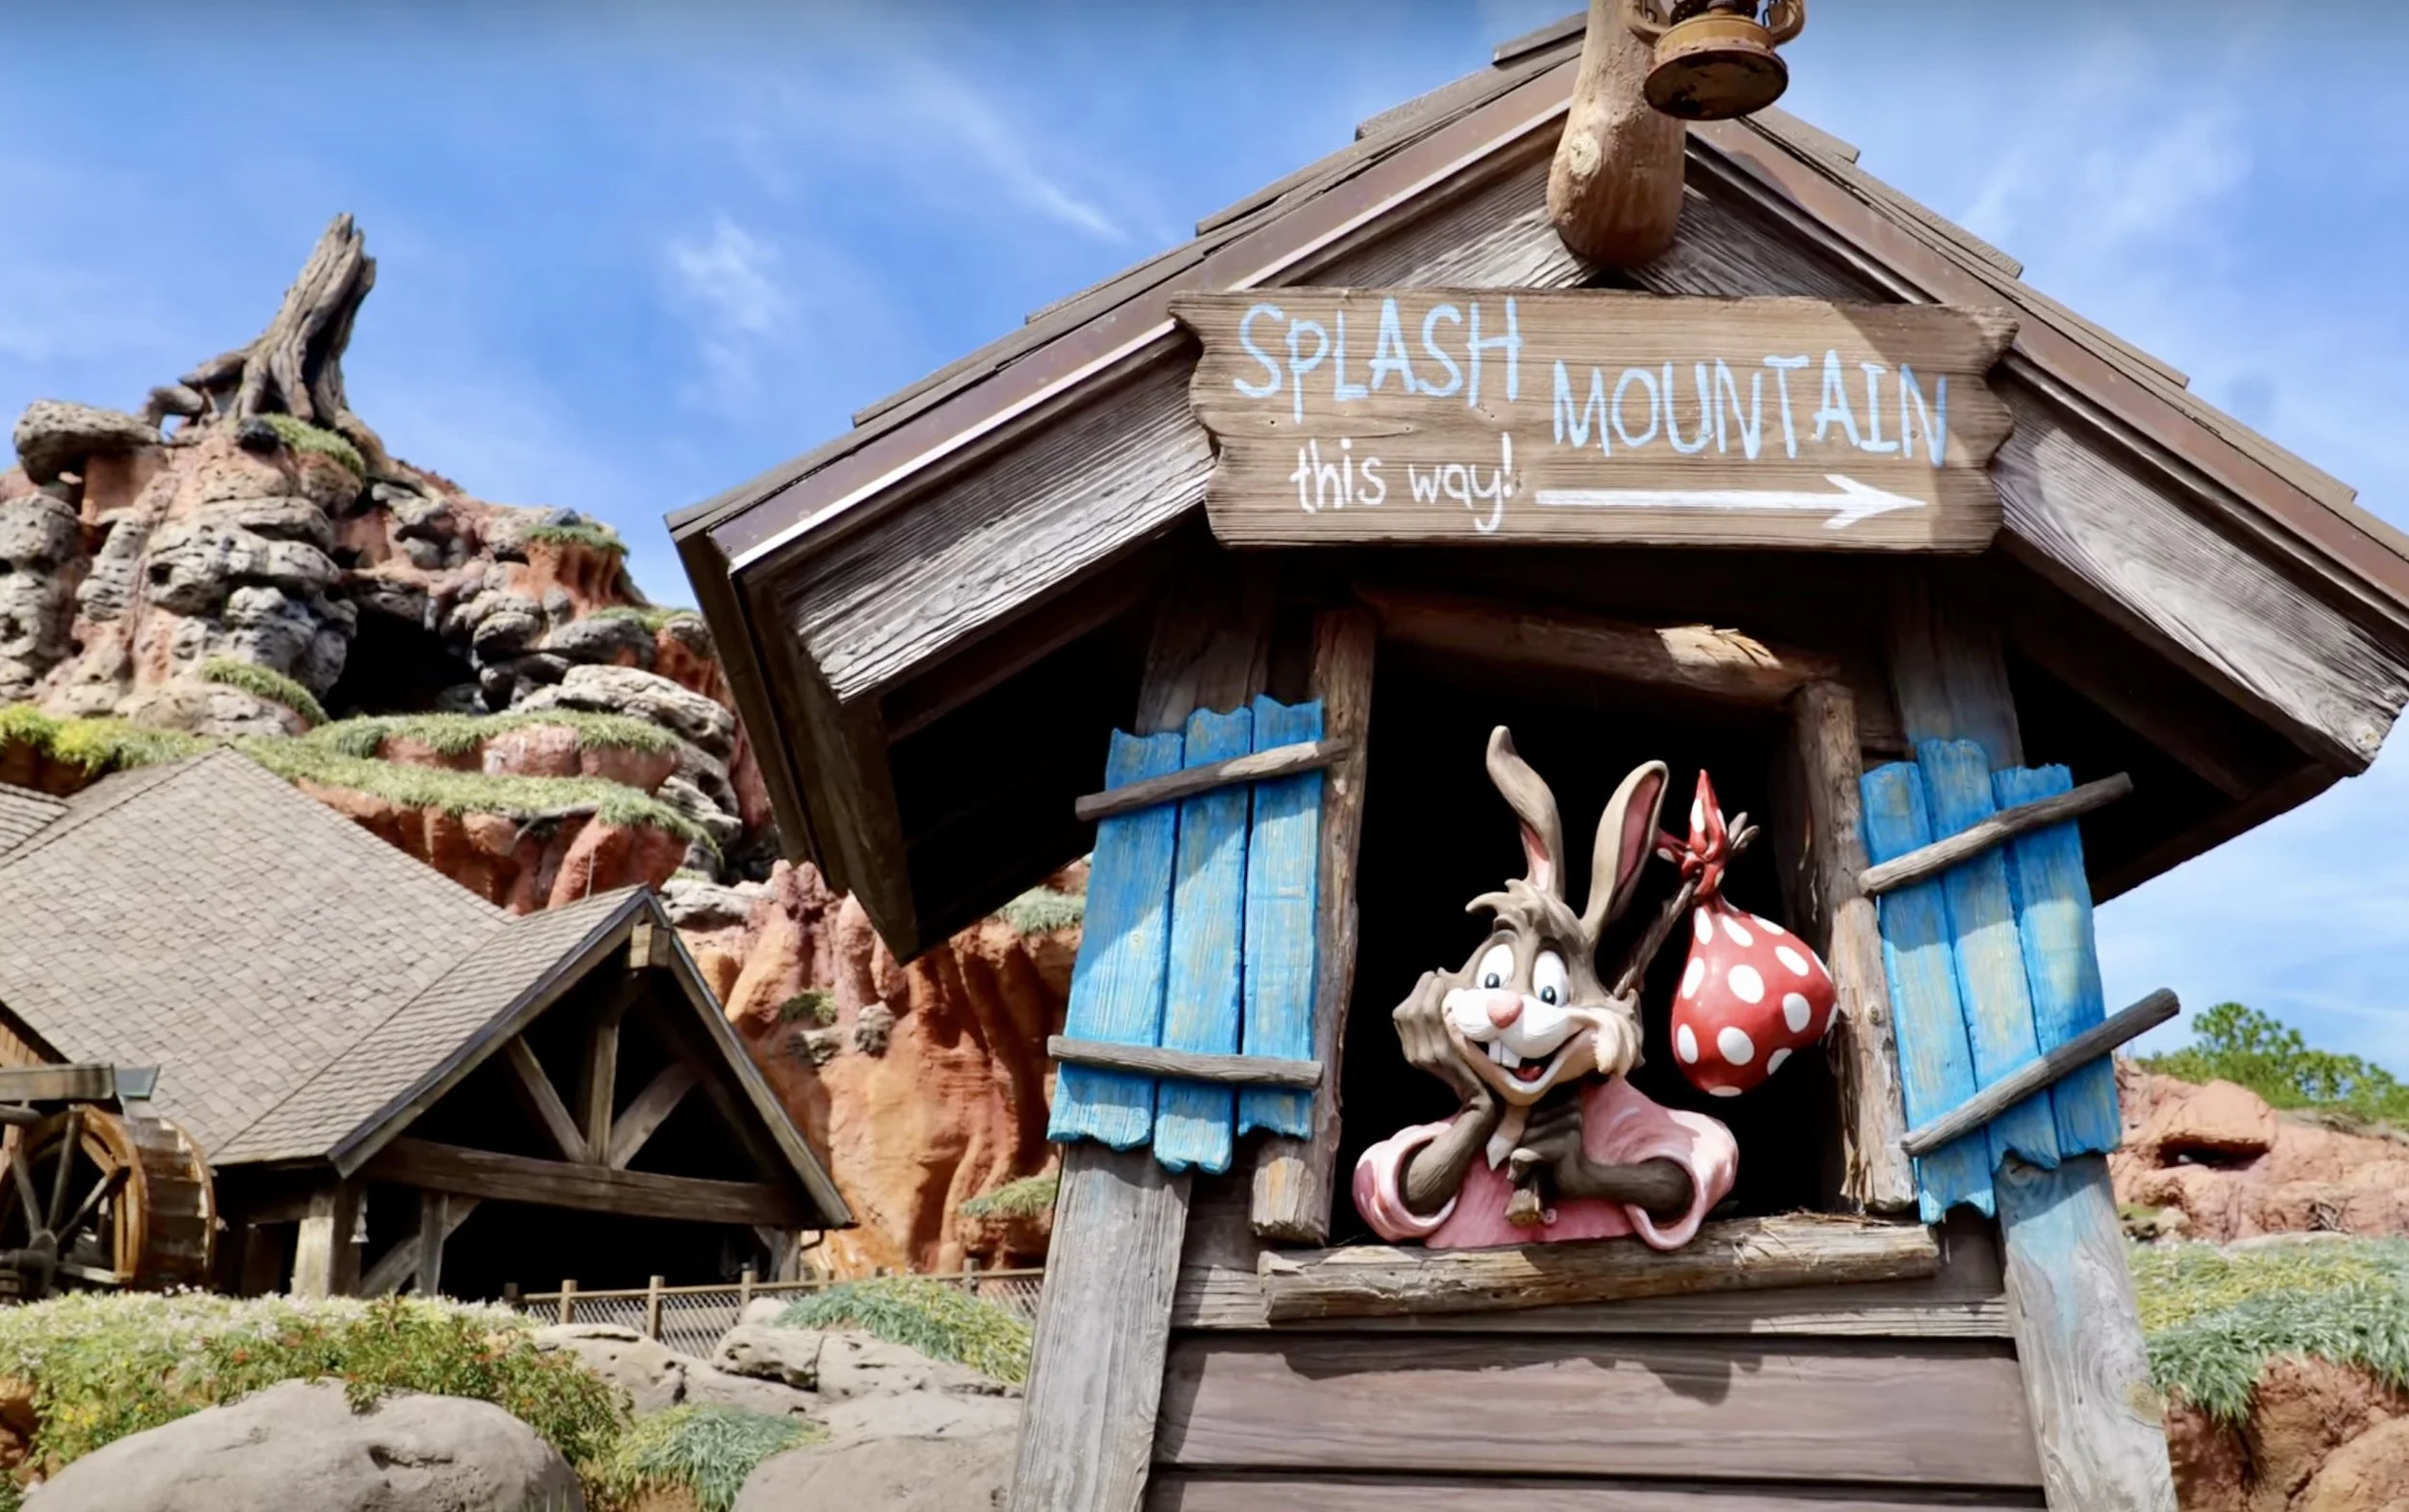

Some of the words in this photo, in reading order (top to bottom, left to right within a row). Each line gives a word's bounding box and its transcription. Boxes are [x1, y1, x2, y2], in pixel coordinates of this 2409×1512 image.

[1232, 297, 1522, 423] SPLASH
[1552, 349, 1948, 468] MOUNTAIN
[1288, 438, 1387, 513] this
[1407, 432, 1514, 533] way!
